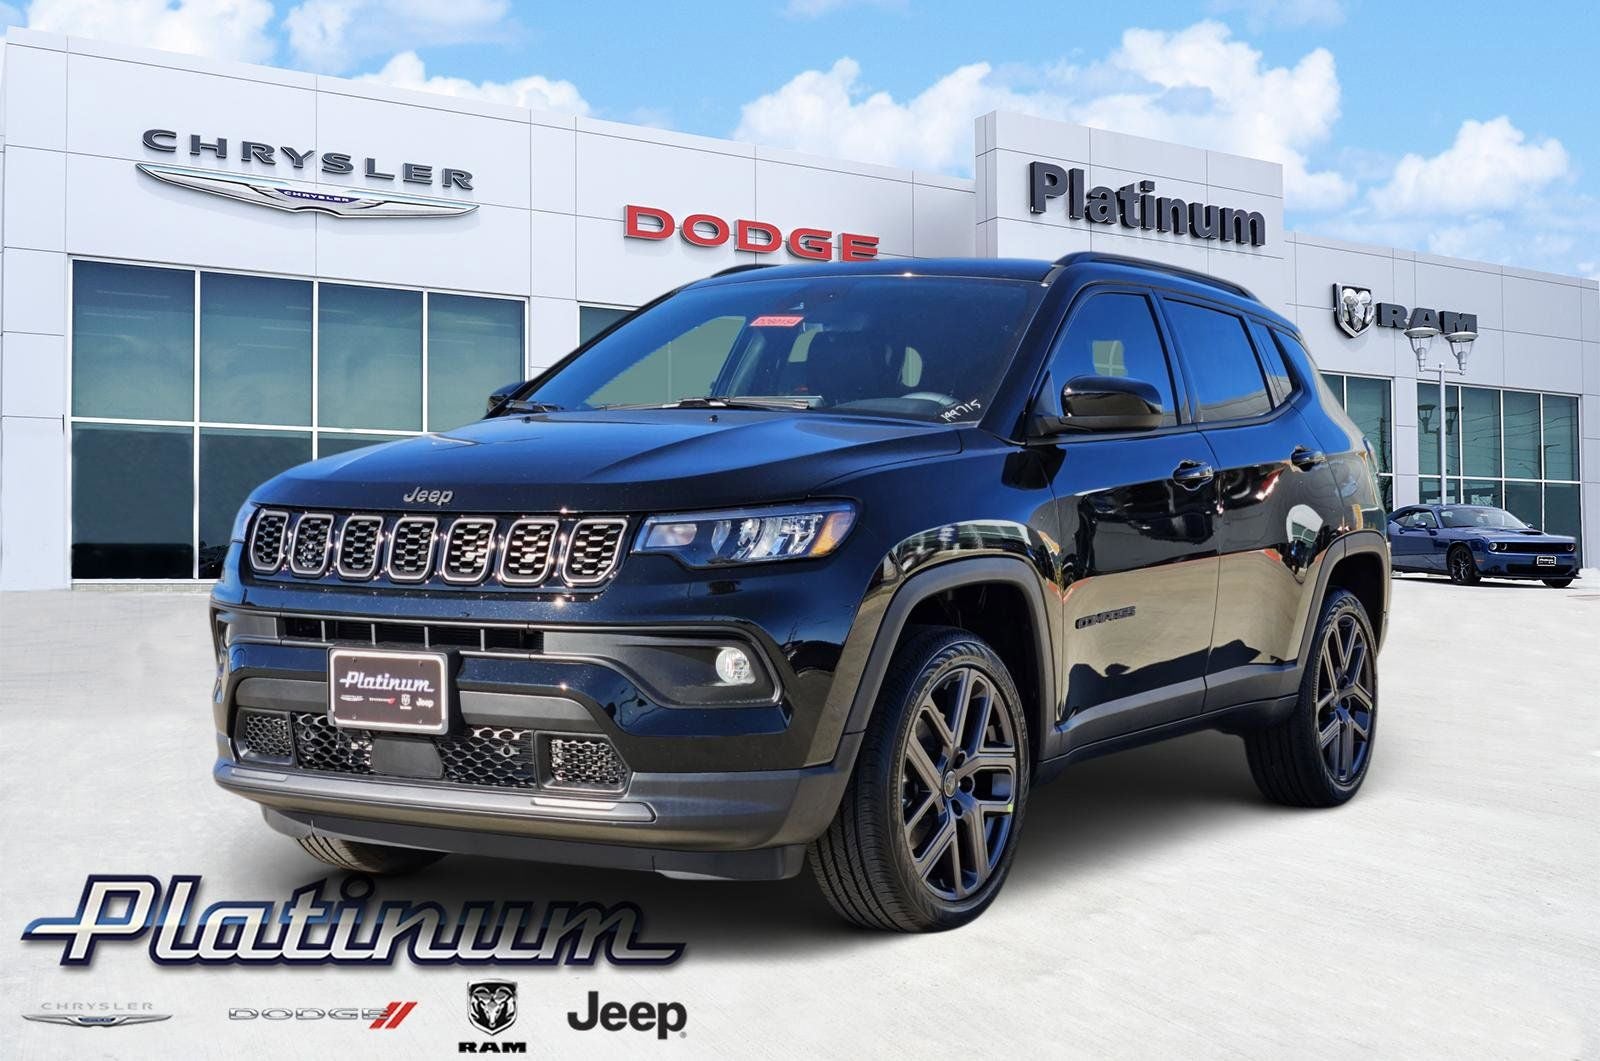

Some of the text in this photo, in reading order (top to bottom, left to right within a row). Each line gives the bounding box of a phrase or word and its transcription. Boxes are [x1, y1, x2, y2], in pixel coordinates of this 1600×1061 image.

[142, 128, 474, 190] CHRYSLER
[284, 191, 349, 202] CHRYSLER
[1029, 160, 1266, 247] Platinum
[624, 204, 880, 262] DODGE
[1376, 302, 1478, 334] RAM
[403, 486, 453, 506] Jeep
[1075, 605, 1136, 629] COMPASS
[339, 671, 435, 692] Platinum
[416, 698, 434, 709] Jeep
